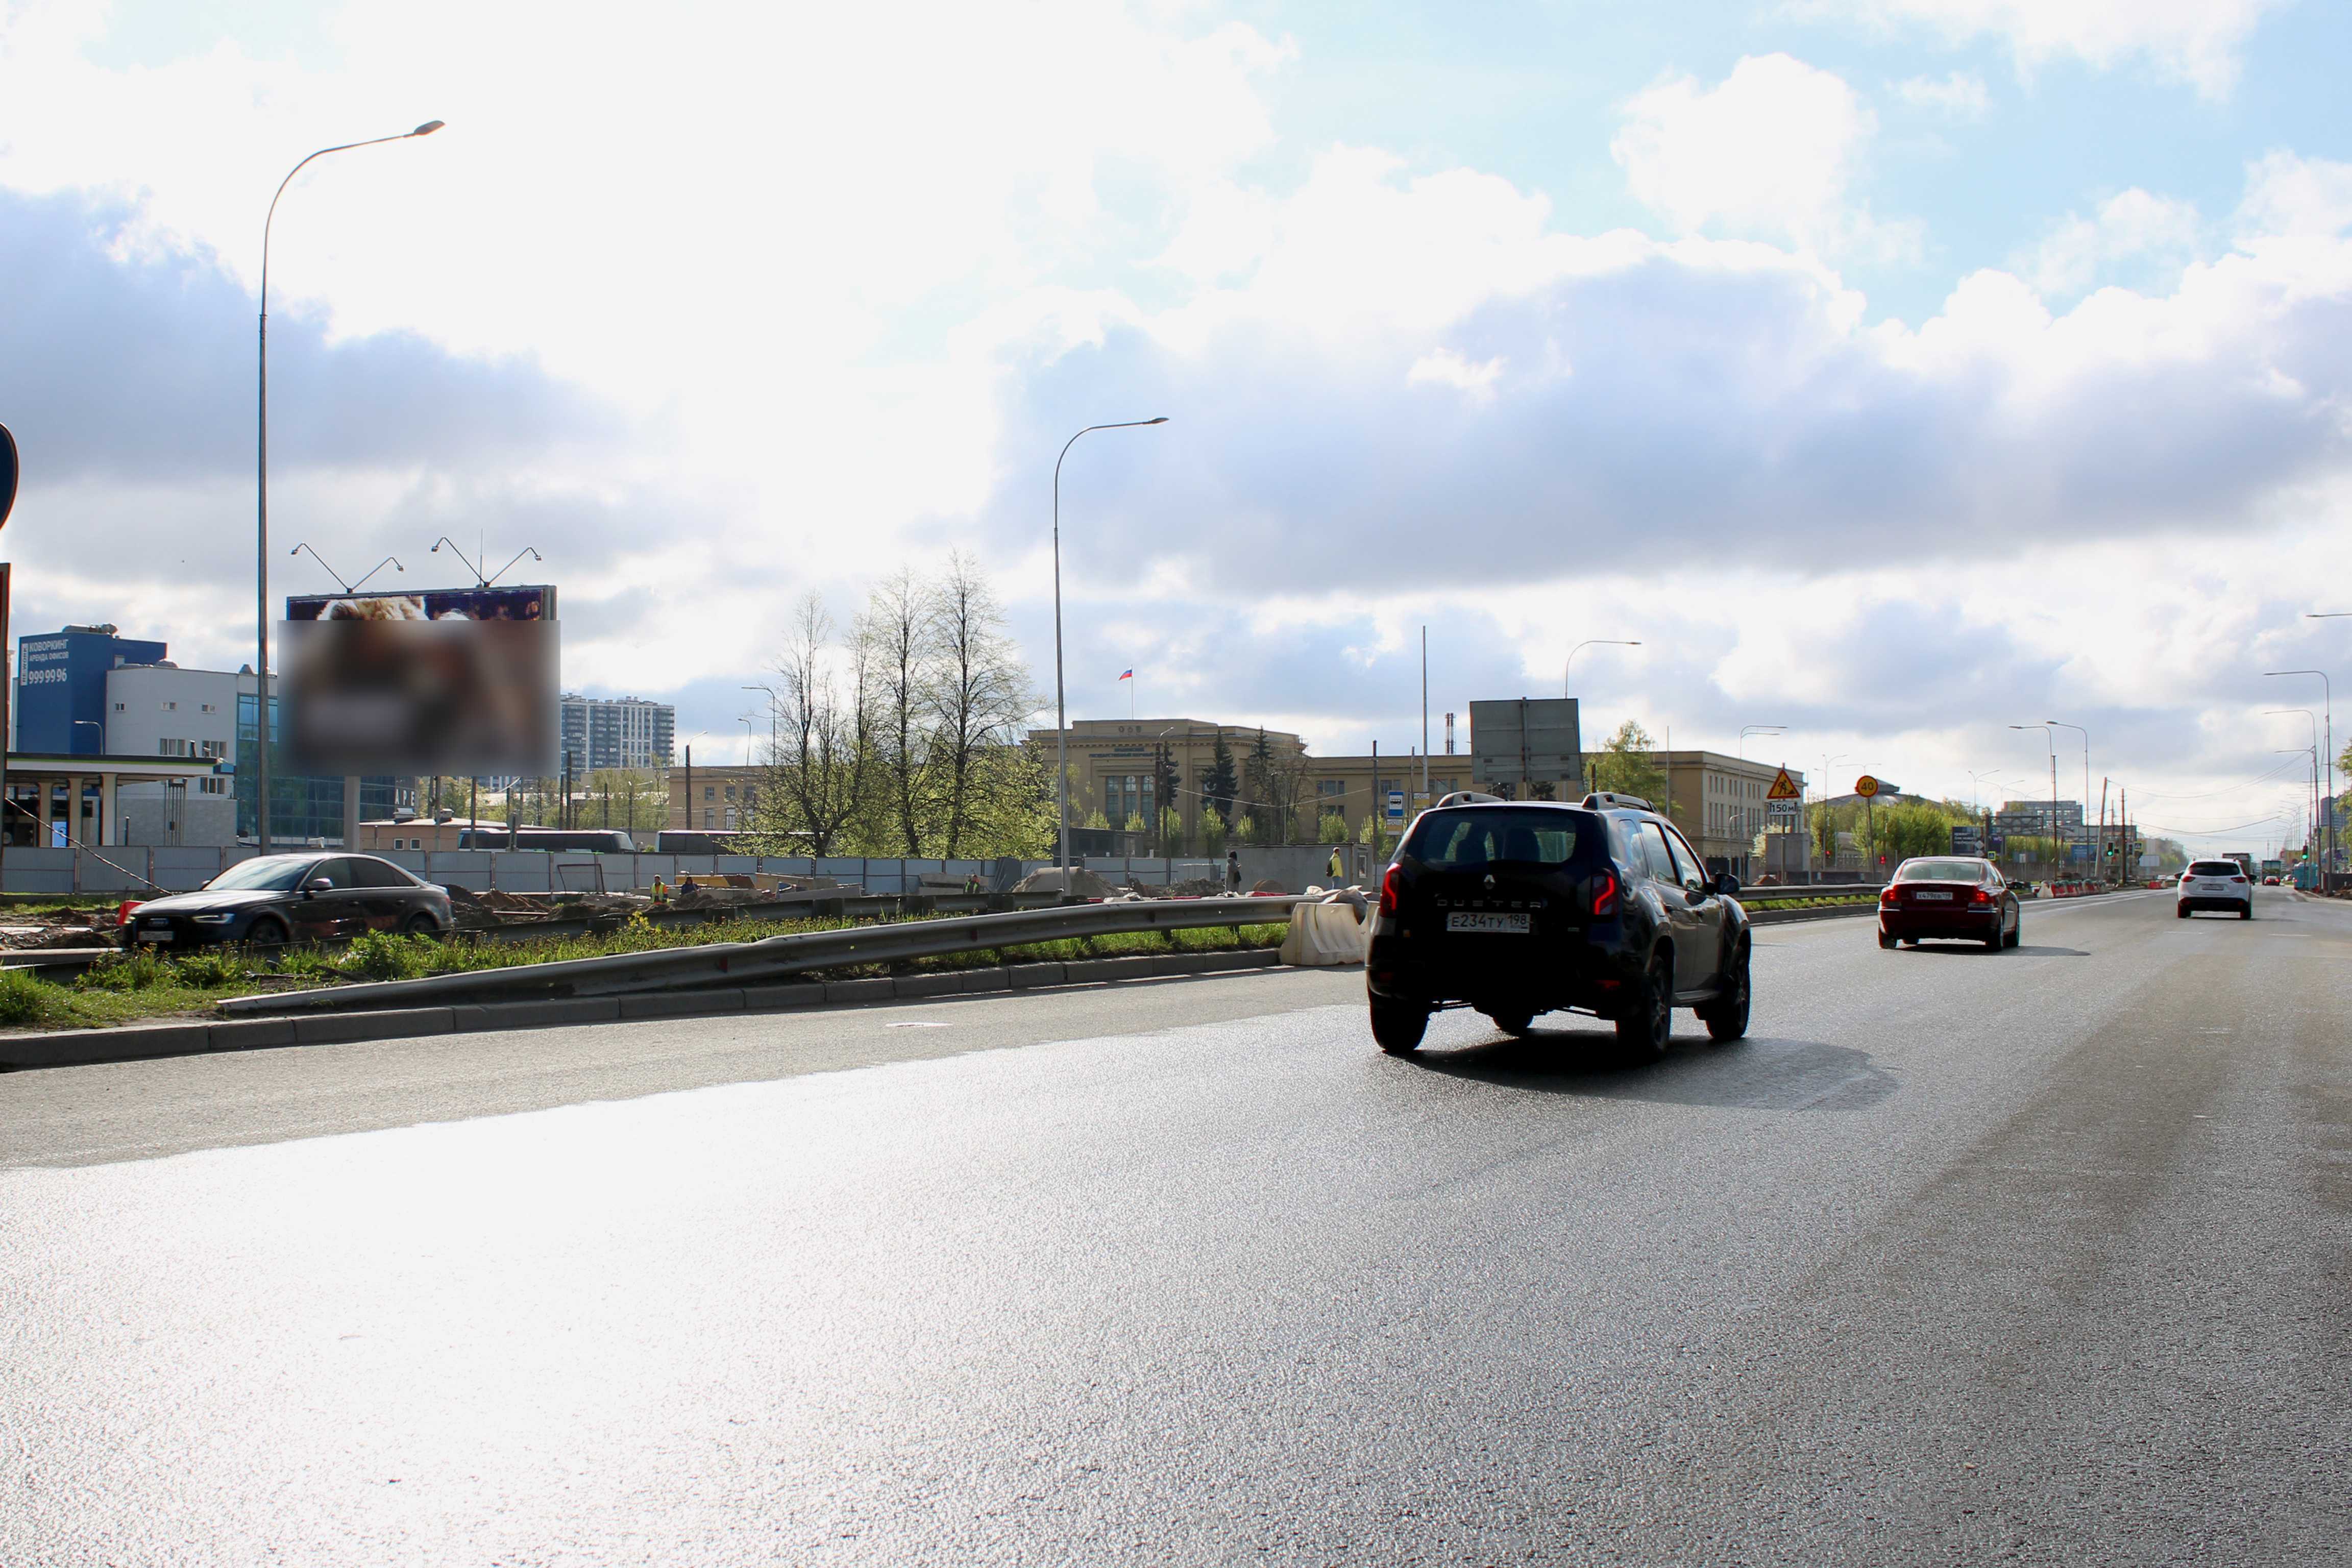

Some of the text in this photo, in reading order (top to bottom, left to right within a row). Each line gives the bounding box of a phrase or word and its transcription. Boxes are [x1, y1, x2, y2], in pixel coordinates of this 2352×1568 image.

[29, 639, 69, 652] КОВОРКИНГ
[1861, 782, 1874, 791] 40
[1772, 804, 1787, 813] 150
[1437, 899, 1541, 909] DUSTER
